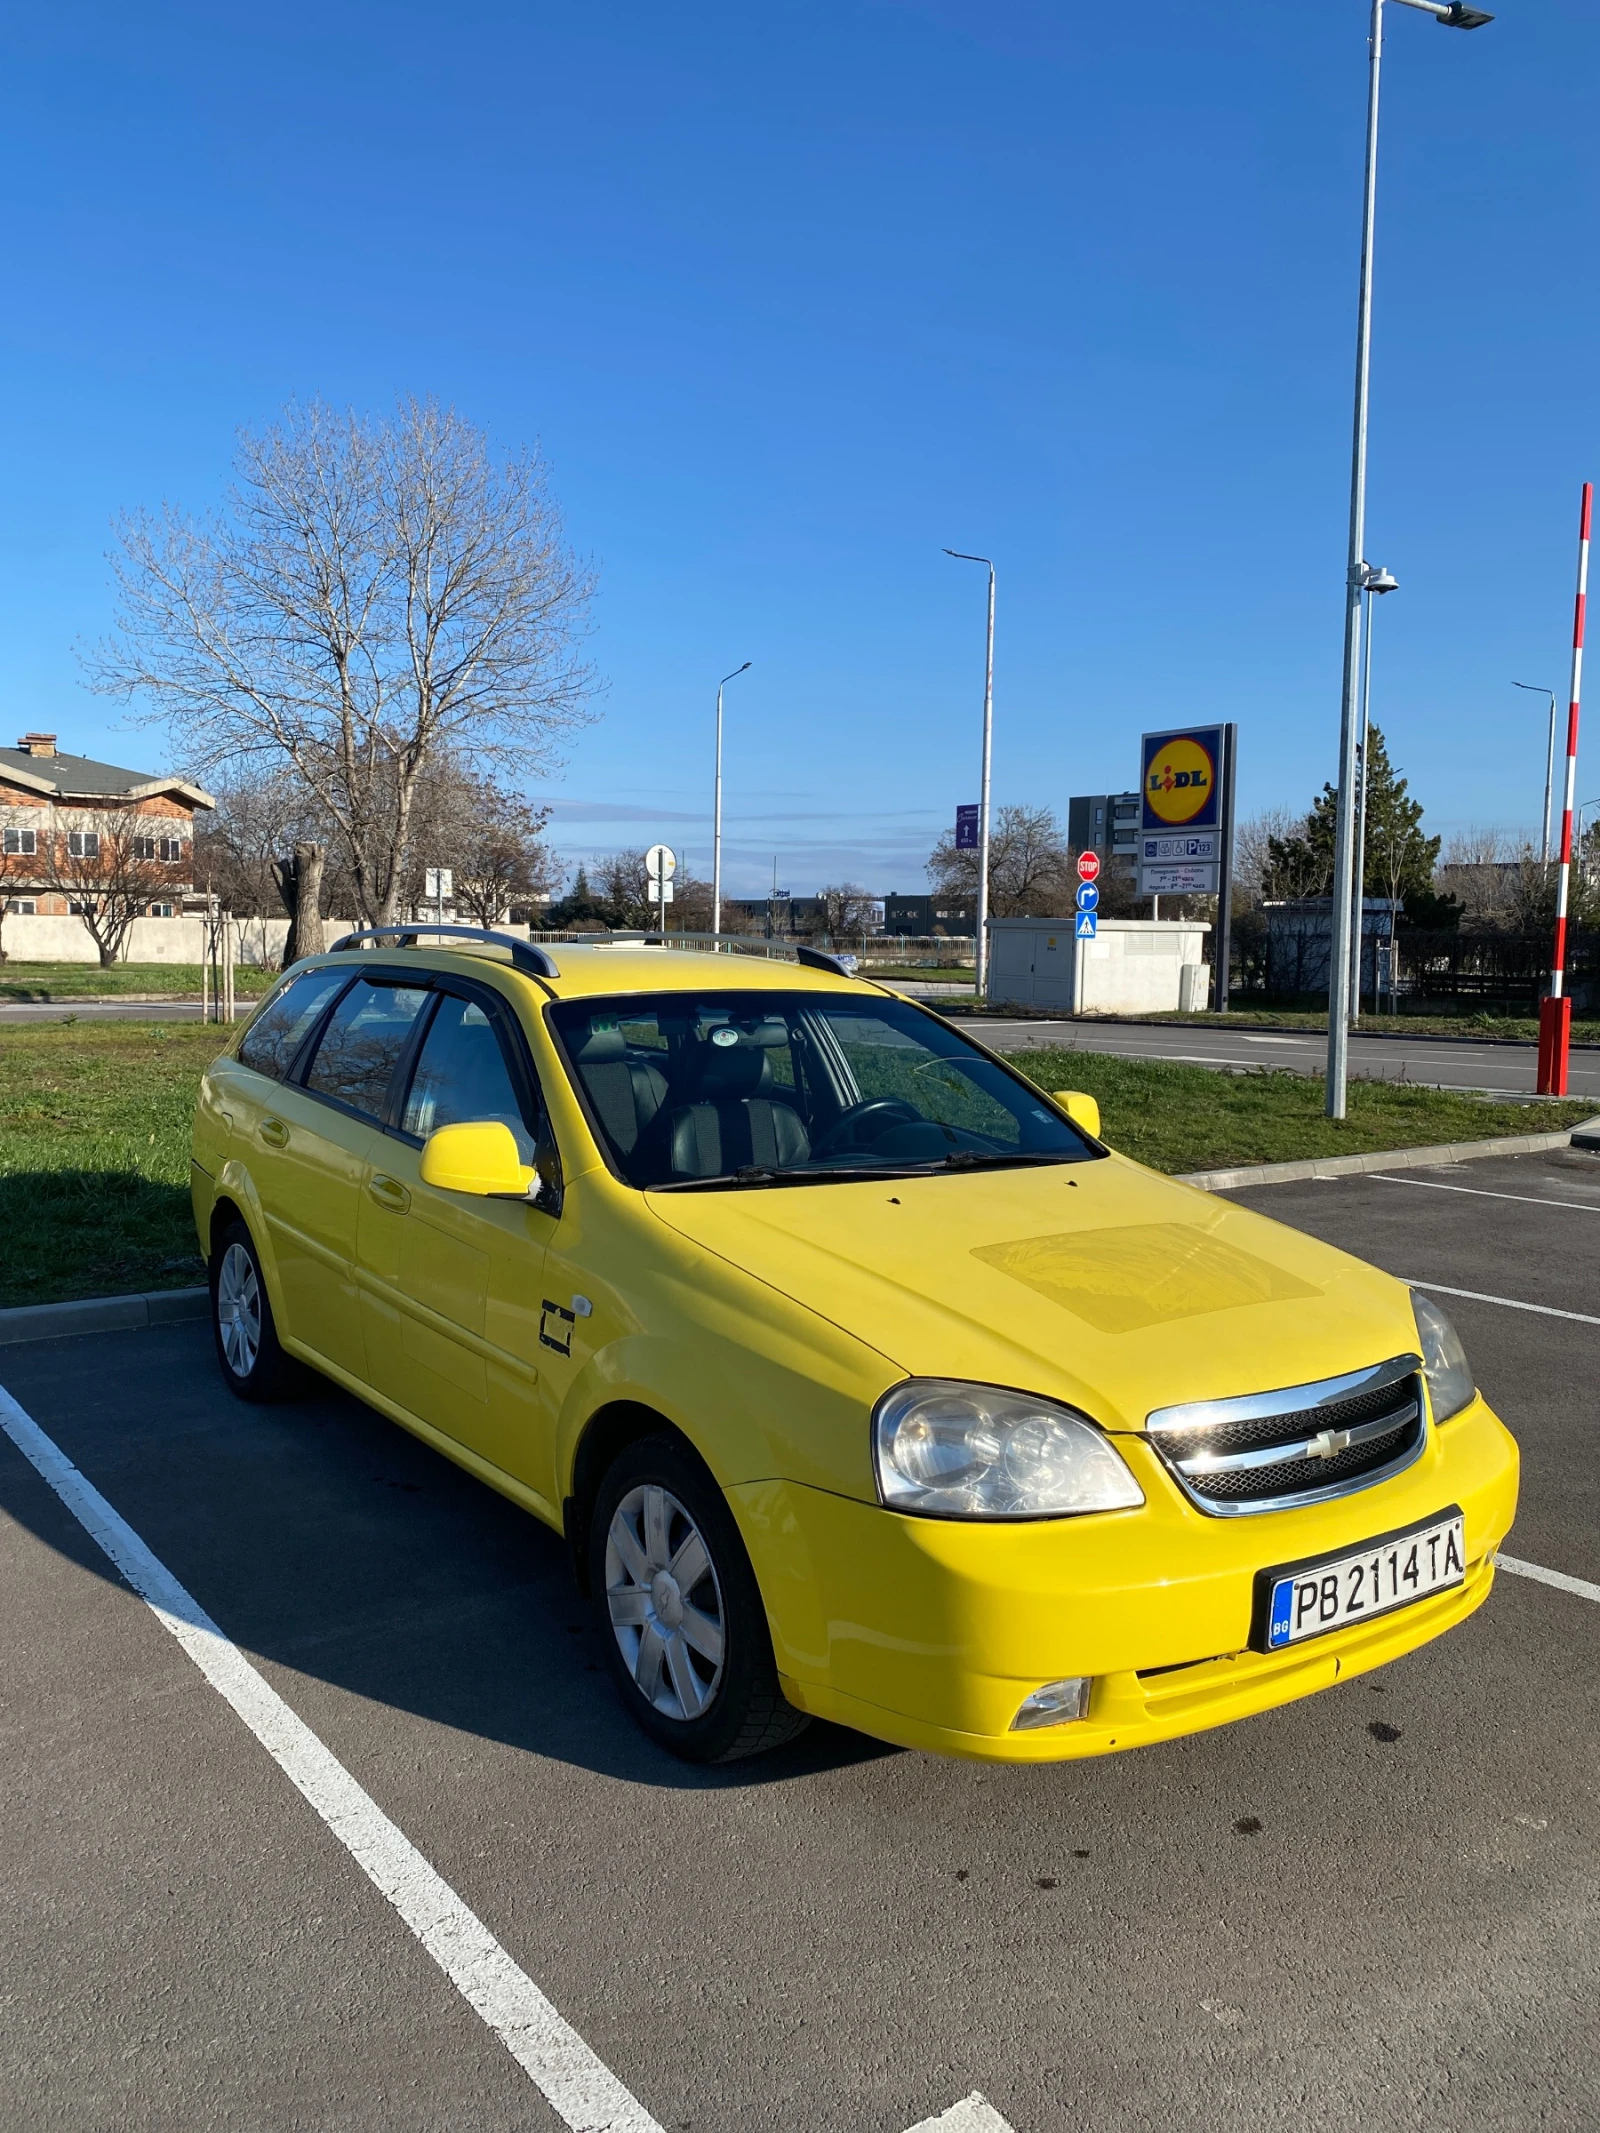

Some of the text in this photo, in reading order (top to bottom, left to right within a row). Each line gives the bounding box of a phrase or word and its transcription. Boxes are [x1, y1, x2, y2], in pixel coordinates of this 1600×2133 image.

[1199, 844, 1211, 852] 123
[1080, 861, 1097, 872] STOP
[1273, 1620, 1289, 1636] BG
